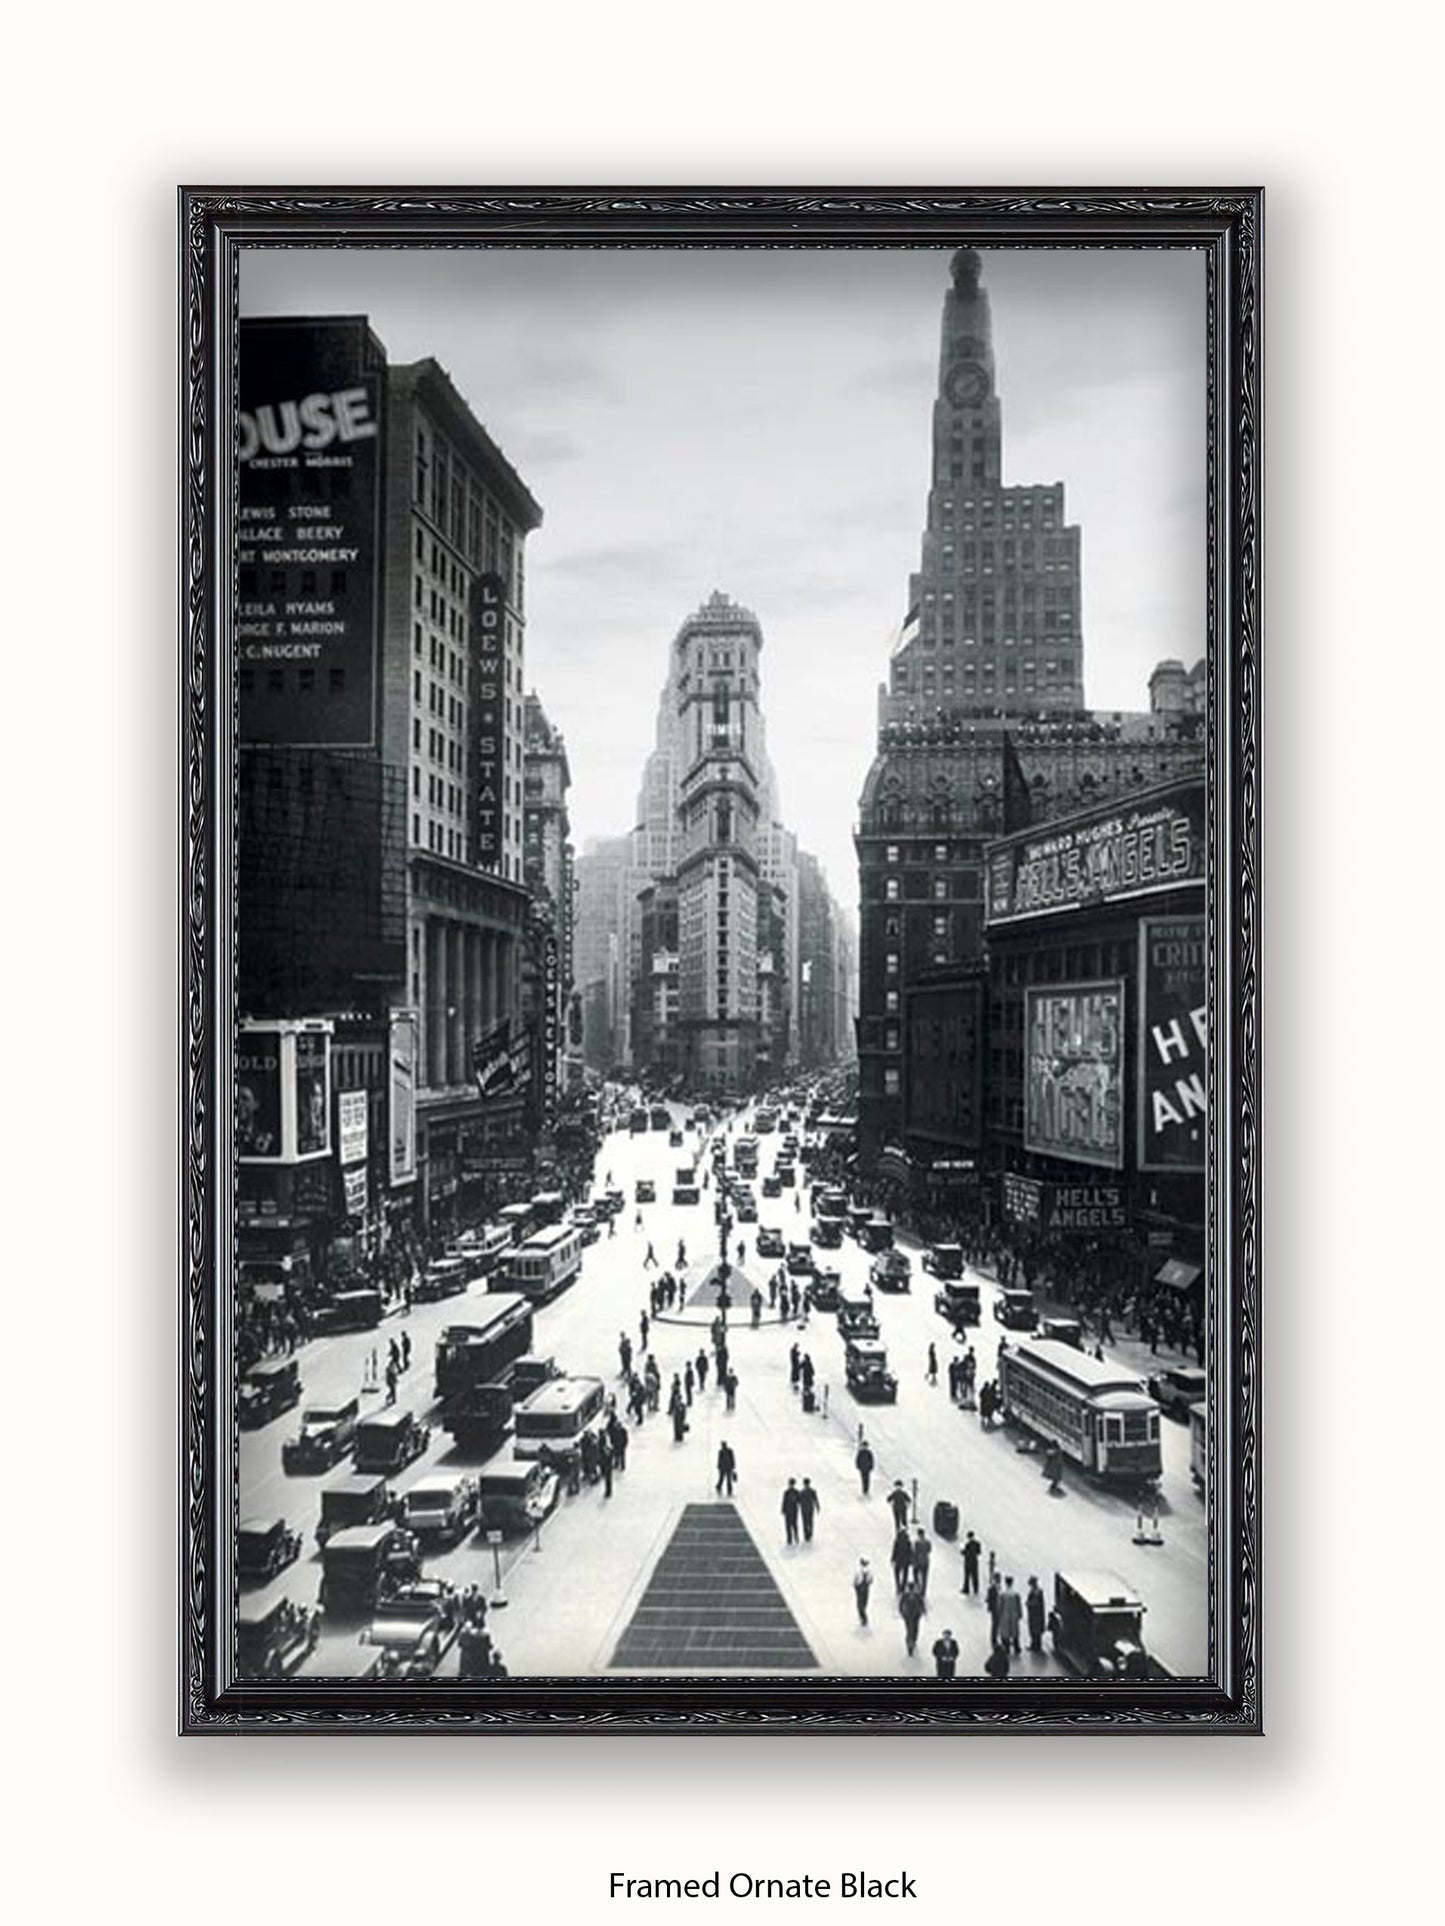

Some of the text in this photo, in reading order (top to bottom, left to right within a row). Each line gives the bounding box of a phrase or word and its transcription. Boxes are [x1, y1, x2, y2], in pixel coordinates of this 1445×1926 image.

[250, 456, 353, 469] CHESTER MORRIS
[289, 506, 331, 519] STONE
[297, 526, 344, 541] BEERY
[262, 549, 360, 563] MONTGOMERY
[286, 601, 335, 615] HYAMS
[291, 621, 345, 635] MARION
[479, 736, 497, 851] STATE
[1087, 817, 1190, 892] ANGELS
[1056, 1187, 1120, 1207] HELL'S
[1049, 1207, 1126, 1228] ANGELS
